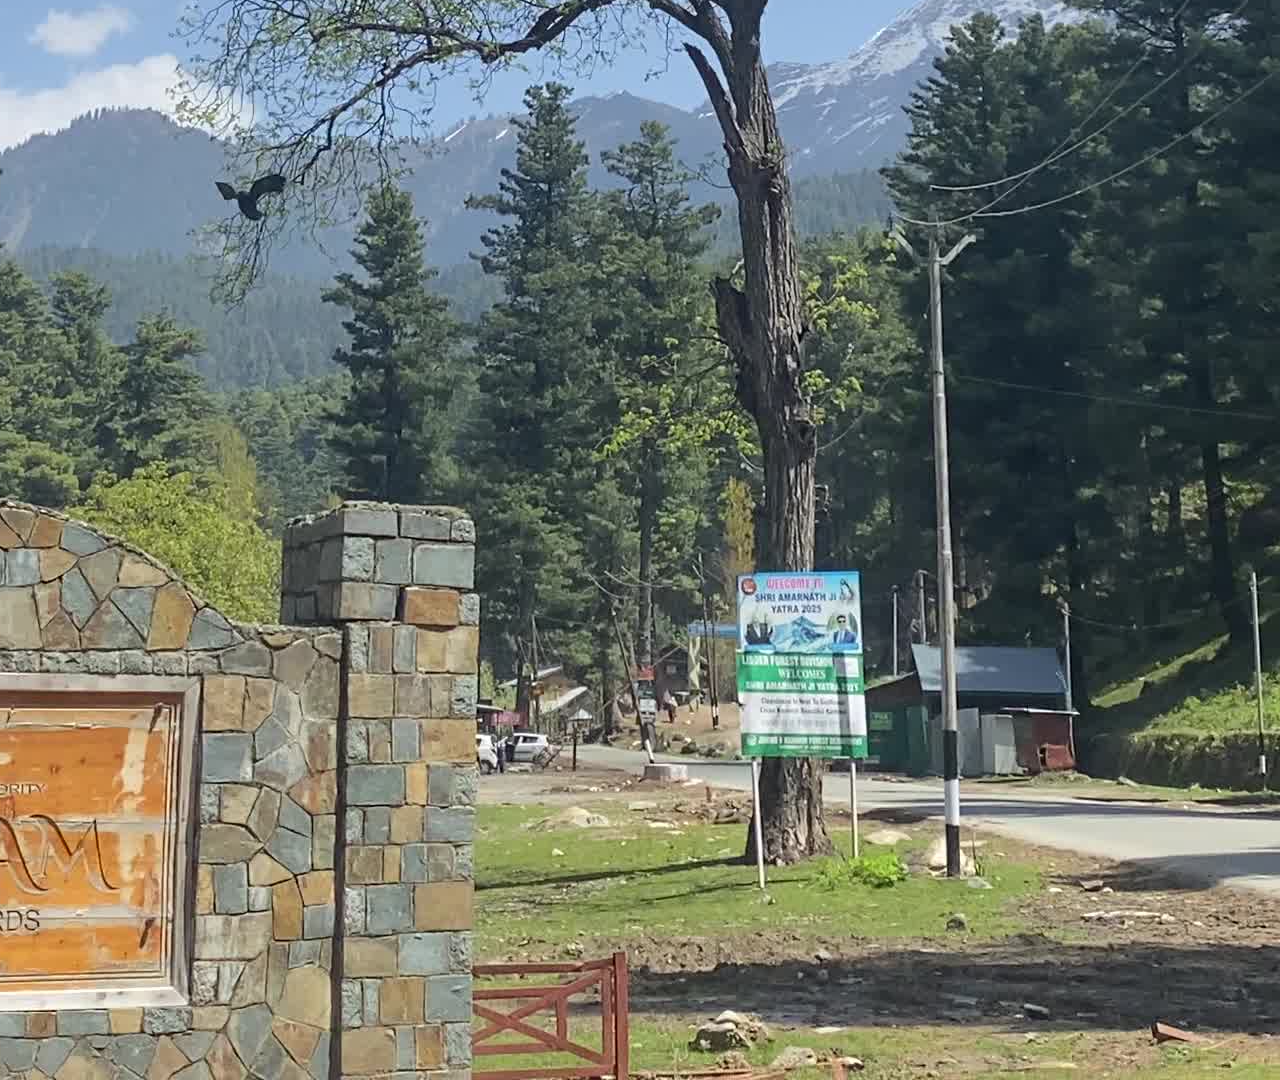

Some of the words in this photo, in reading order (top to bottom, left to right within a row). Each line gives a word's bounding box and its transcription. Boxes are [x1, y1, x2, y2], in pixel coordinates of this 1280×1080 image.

[755, 592, 776, 602] SHRI
[779, 592, 826, 601] AMARNATH
[829, 592, 837, 601] JI
[771, 605, 799, 614] YATRA
[801, 604, 822, 613] 2025
[770, 655, 800, 666] FOREST
[778, 668, 826, 680] WELCOMES
